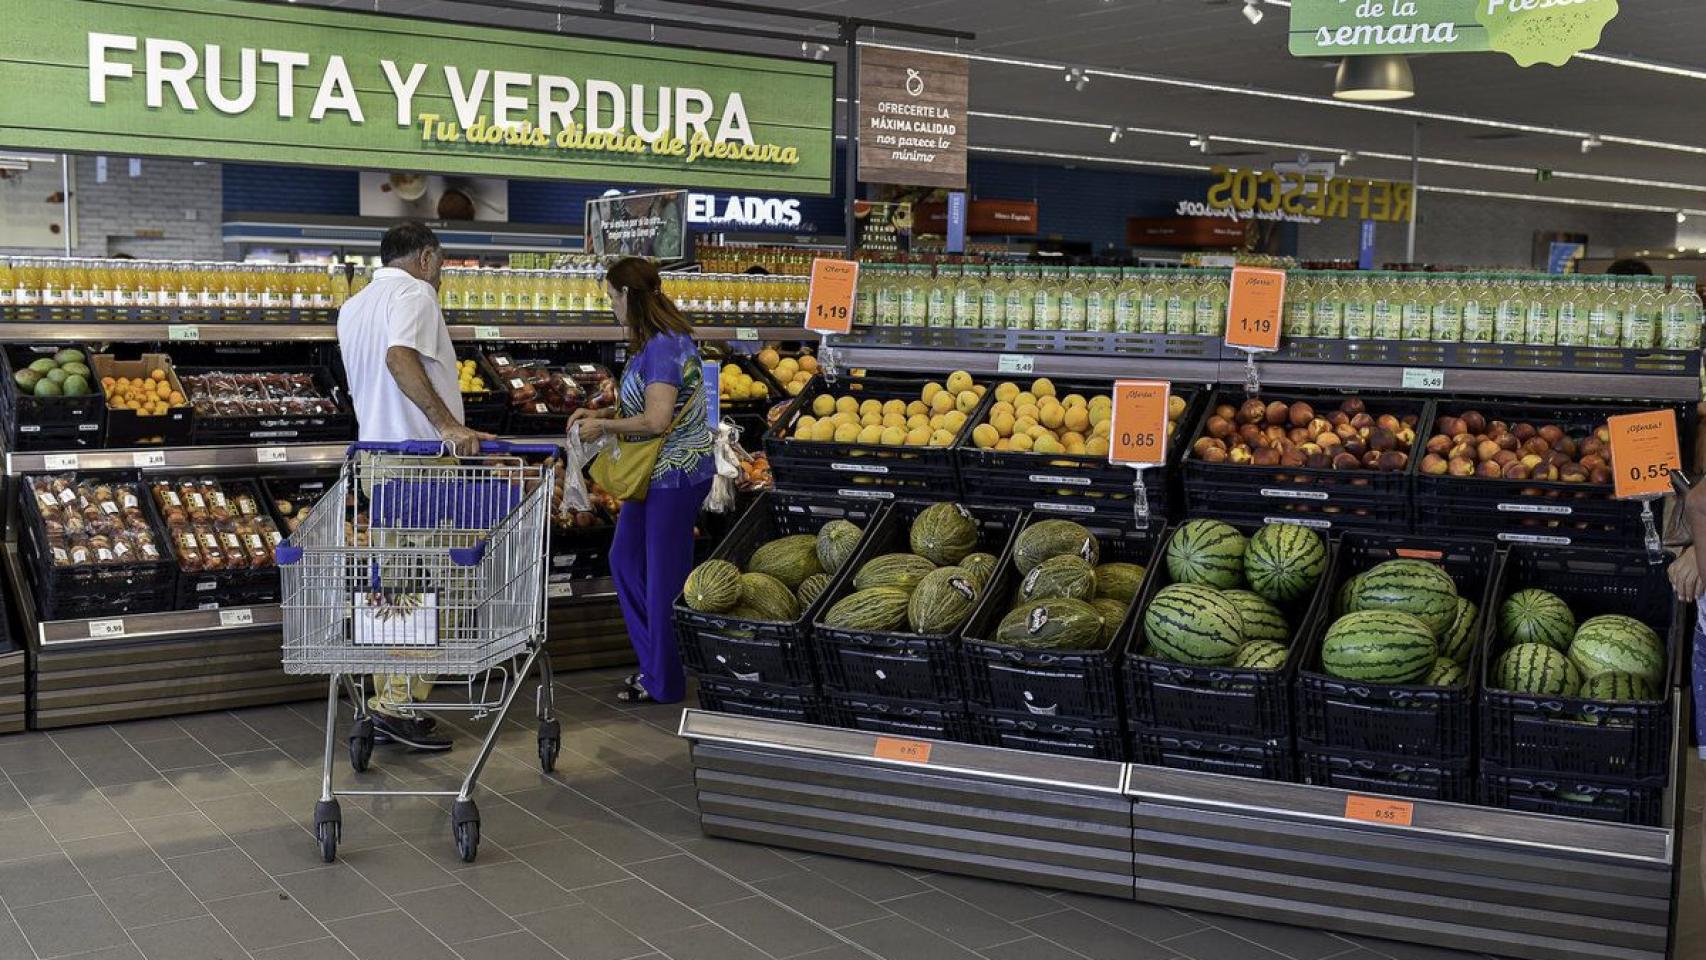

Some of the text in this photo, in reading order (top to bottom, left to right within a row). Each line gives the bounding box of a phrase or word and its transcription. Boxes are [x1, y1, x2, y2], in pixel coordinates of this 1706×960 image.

[1355, 0, 1418, 17] de la
[1315, 22, 1458, 47] semana
[88, 32, 754, 147] FRUTA Y VERDURA
[878, 102, 950, 119] OFRECERTE LA
[871, 115, 956, 135] MÁXIMA CALIDAD
[418, 113, 800, 164] Tu dosis diaria de frescura
[876, 135, 951, 149] nos parece lo
[892, 149, 936, 162] mínimo
[816, 304, 847, 320] 1,19
[1241, 318, 1271, 334] 1,19
[1423, 378, 1441, 387] 5,49
[1122, 433, 1154, 448] 0,85
[1630, 463, 1670, 481] 0,55
